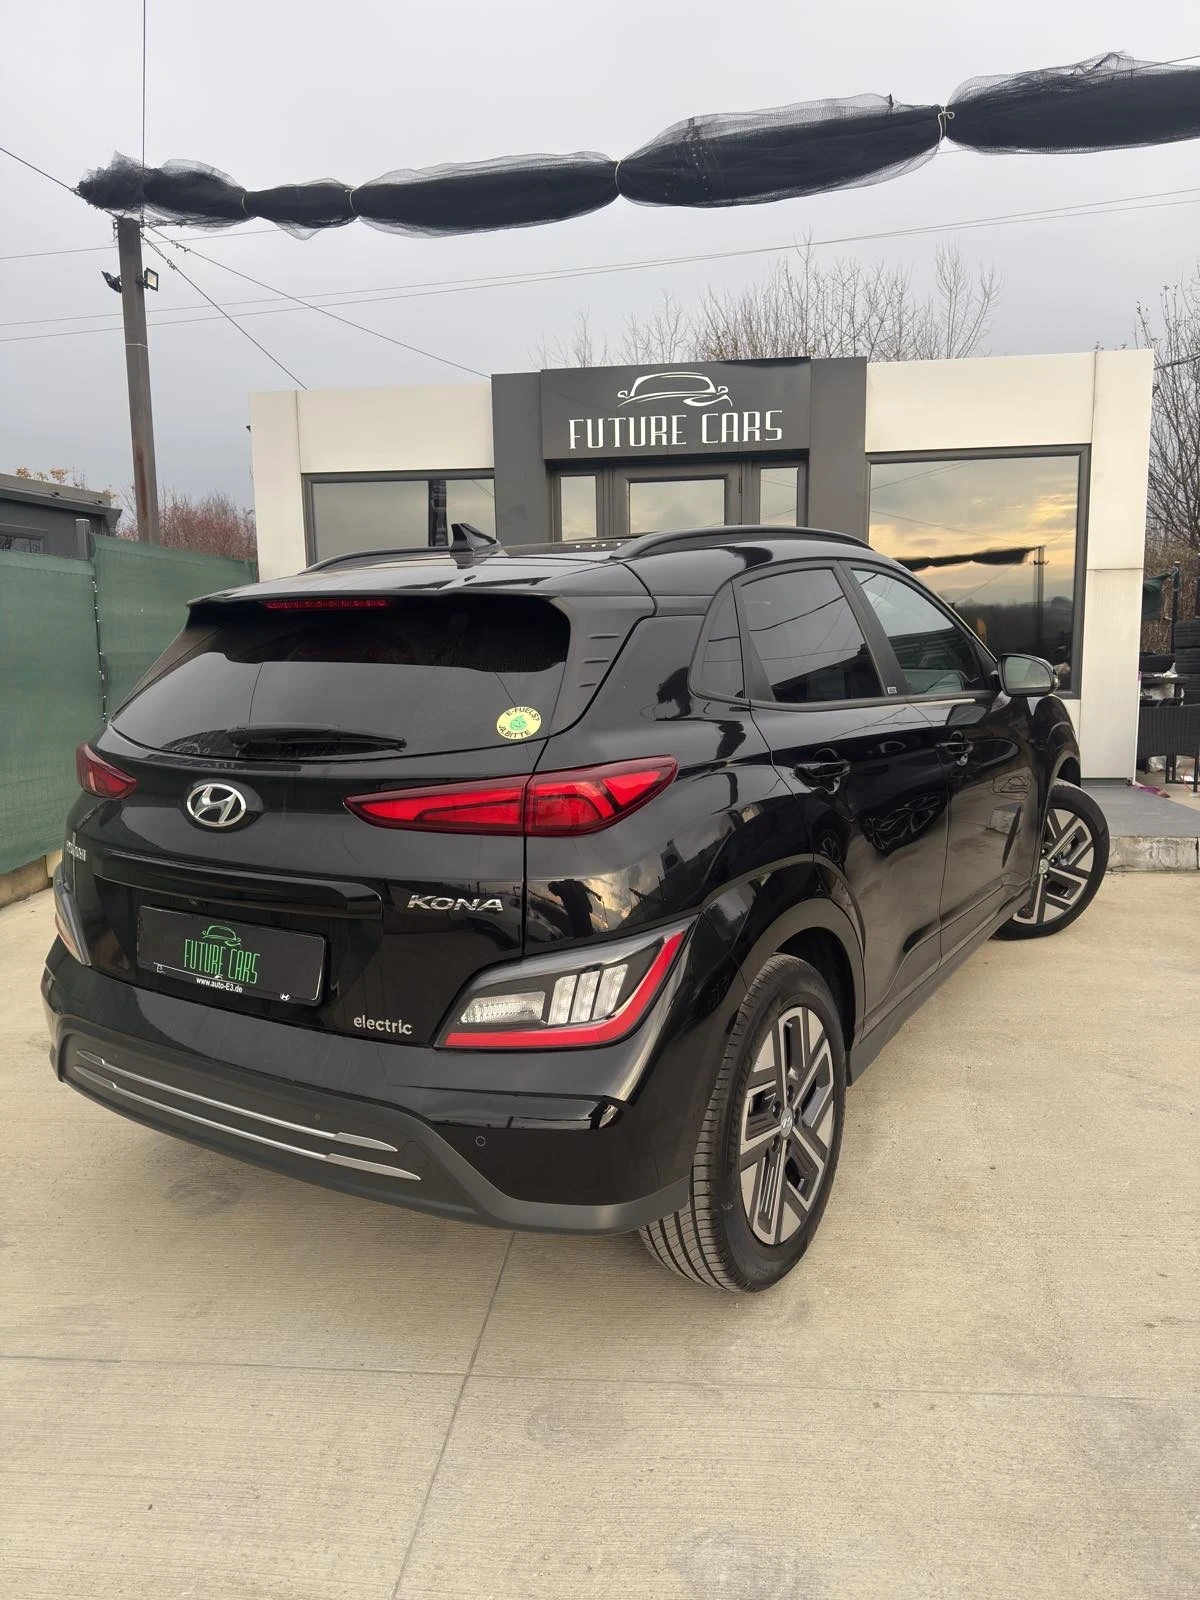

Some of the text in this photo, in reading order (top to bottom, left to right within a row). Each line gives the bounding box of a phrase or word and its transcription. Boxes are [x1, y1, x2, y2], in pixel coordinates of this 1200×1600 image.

[568, 410, 783, 449] FUTURE CARS
[407, 894, 504, 912] KONA
[183, 938, 261, 984] FUTURE CARS
[196, 977, 243, 993] www.auto-E3.de
[353, 1014, 413, 1035] electric
